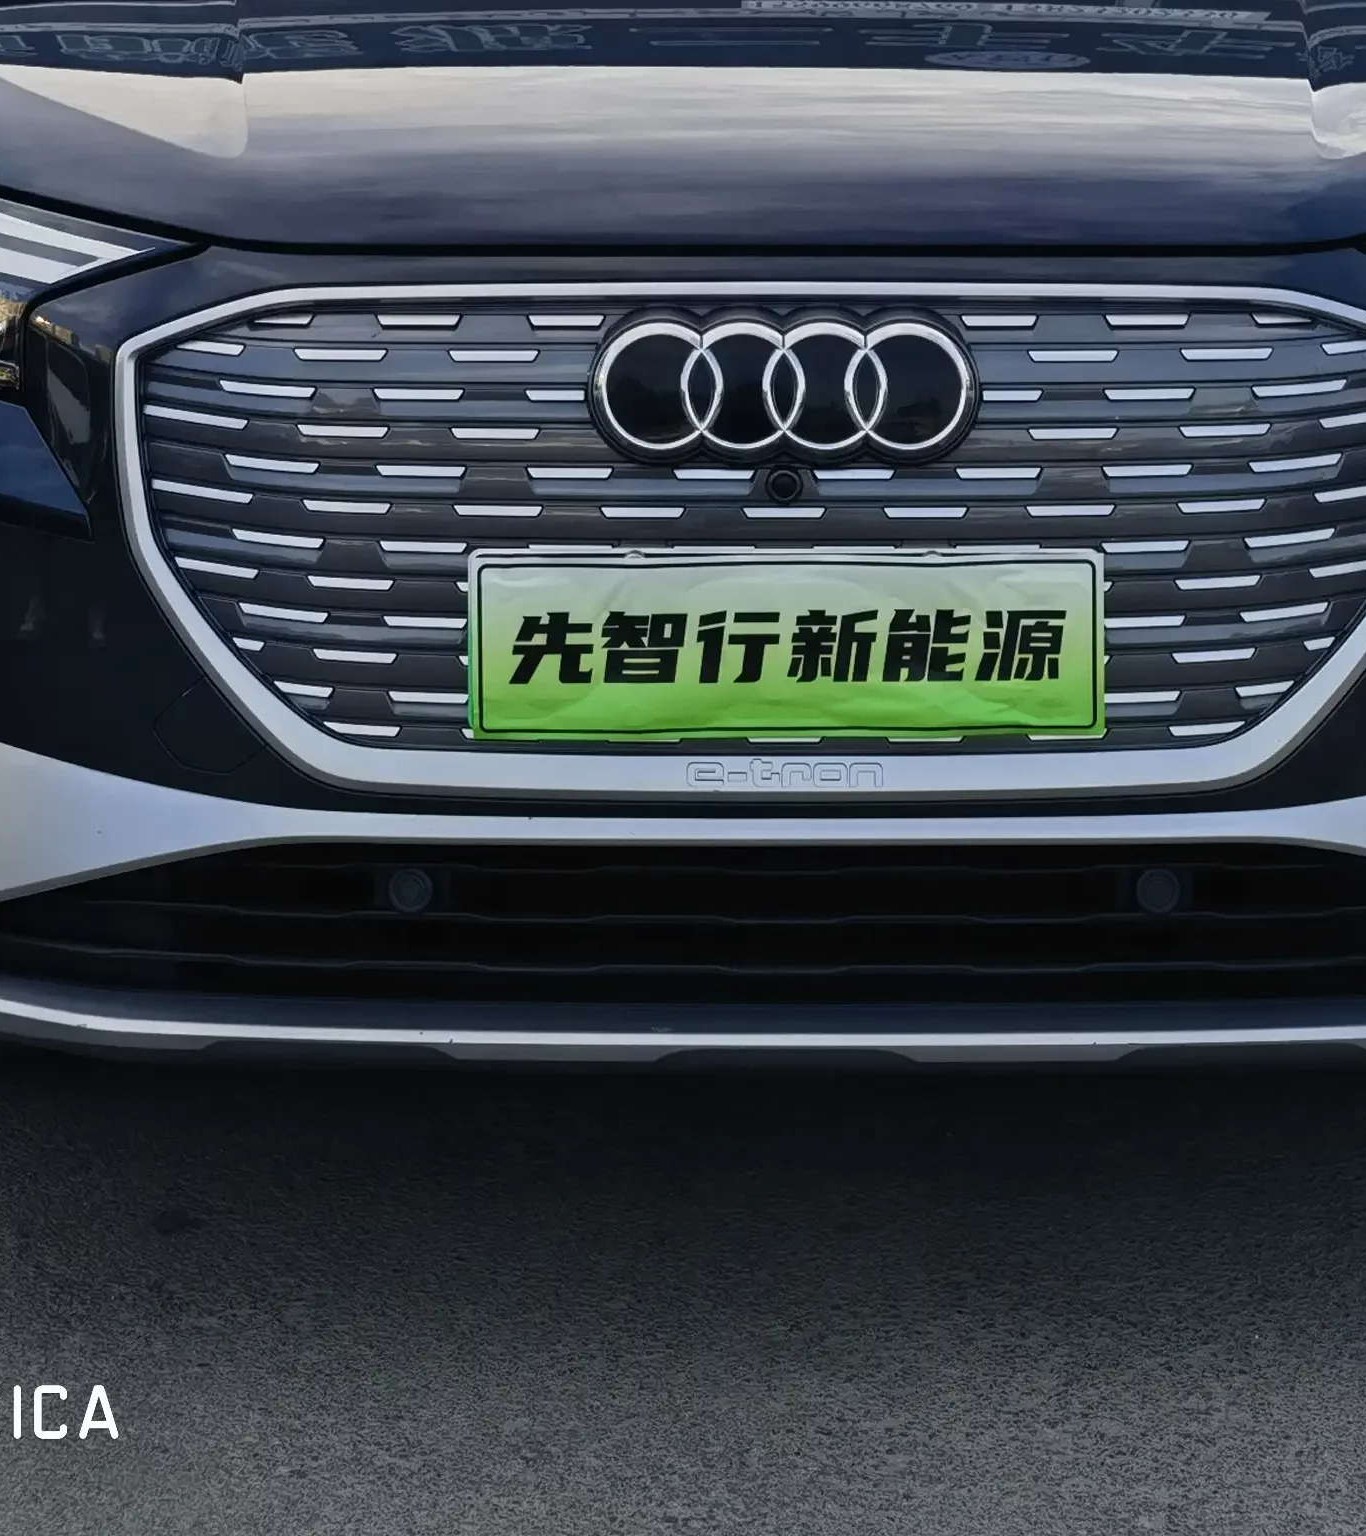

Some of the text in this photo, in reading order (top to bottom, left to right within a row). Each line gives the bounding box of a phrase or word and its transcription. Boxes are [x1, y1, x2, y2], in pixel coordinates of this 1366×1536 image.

[508, 607, 1067, 686] 先智行新能源
[686, 758, 884, 789] e-tron
